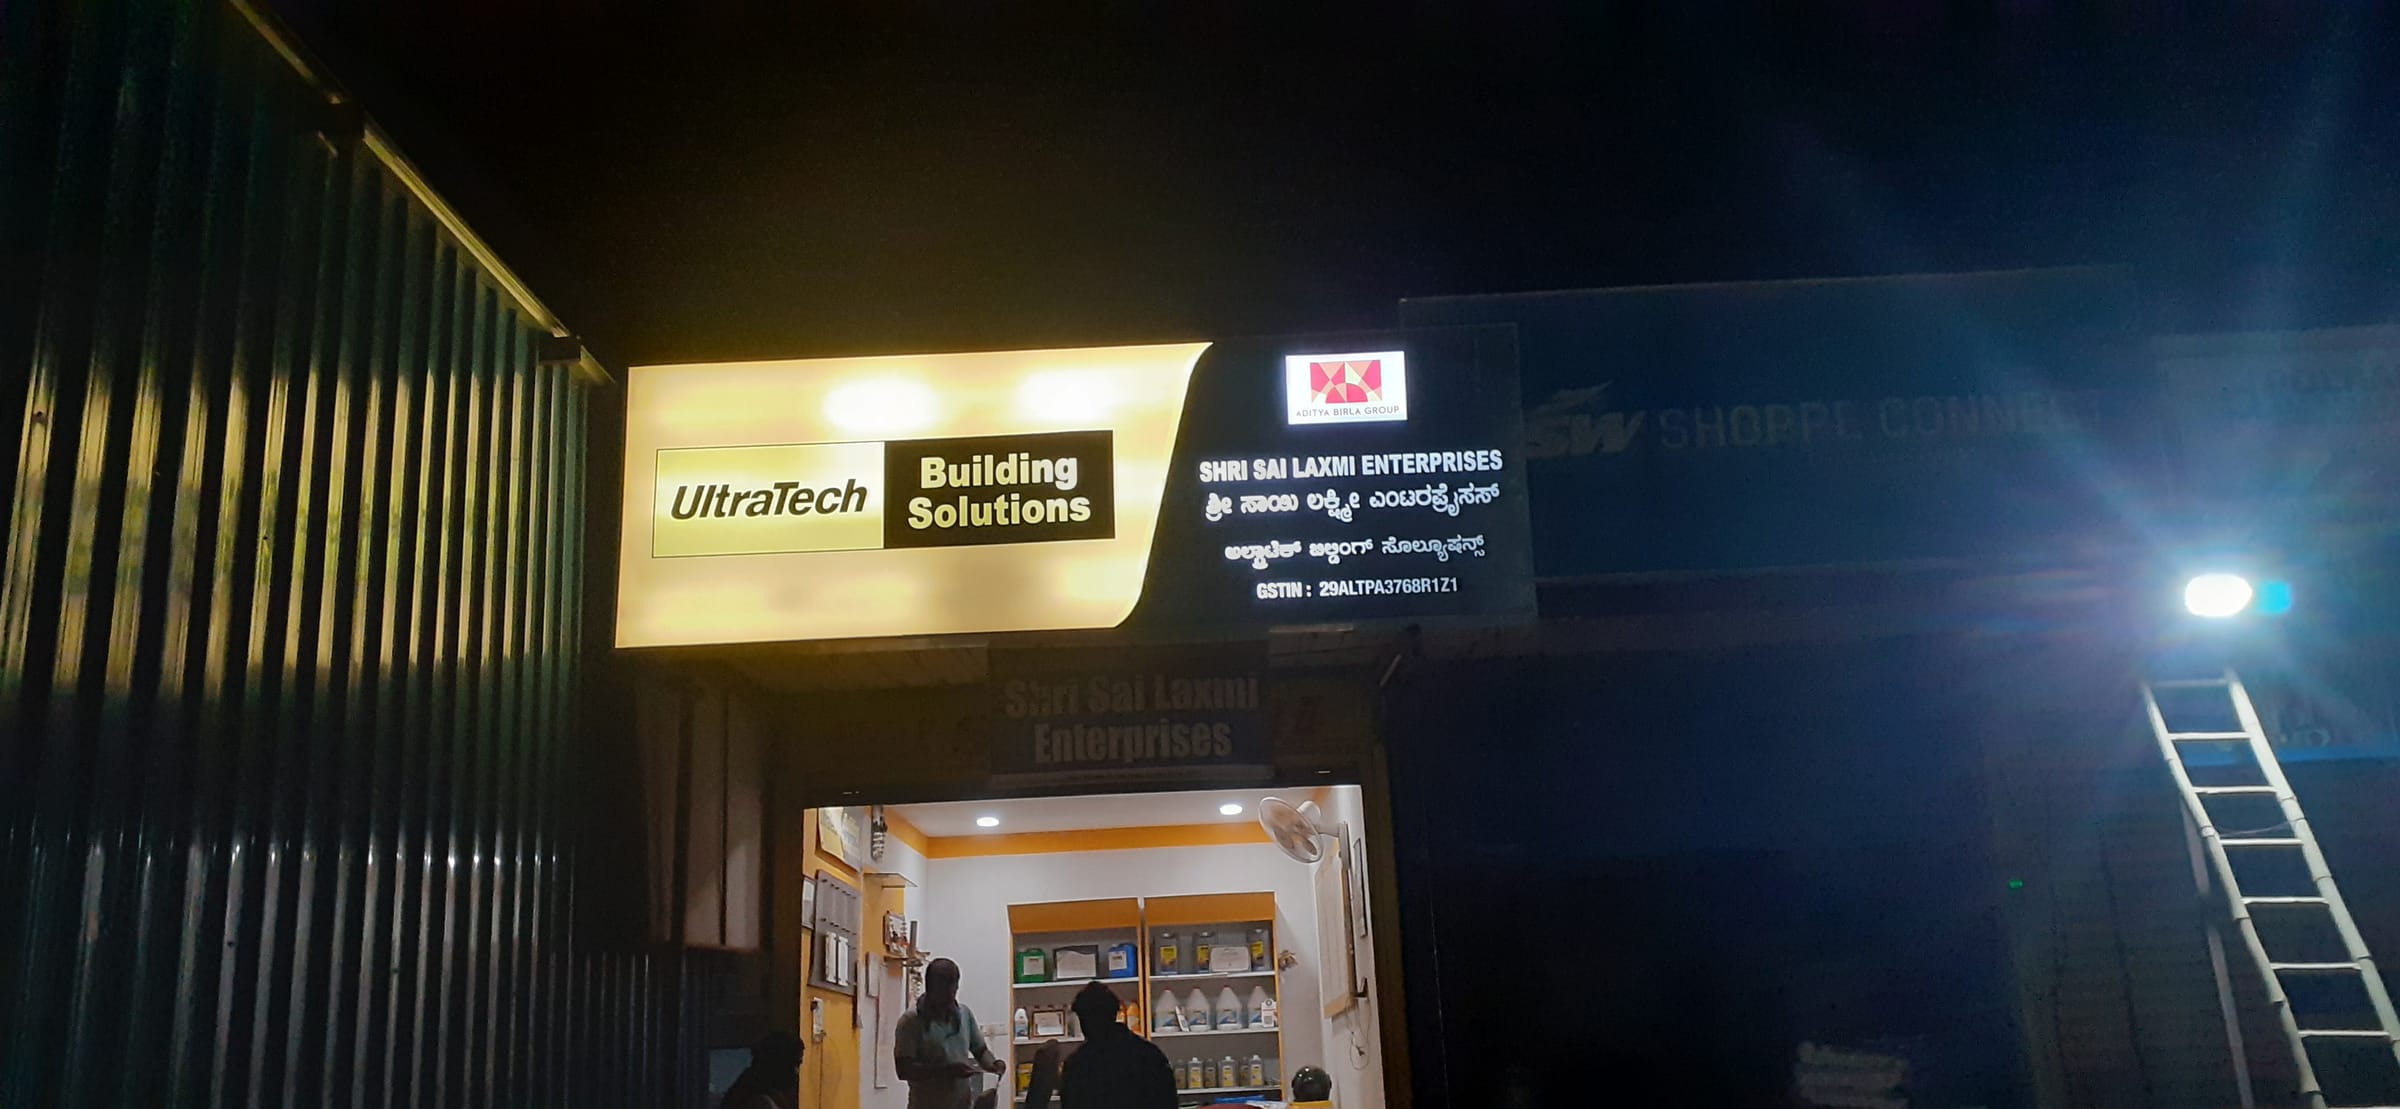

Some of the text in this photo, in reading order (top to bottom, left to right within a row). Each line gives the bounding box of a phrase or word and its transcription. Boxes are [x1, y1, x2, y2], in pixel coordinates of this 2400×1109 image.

[1296, 405, 1400, 417] ADITYA BIRLA GROUP
[920, 452, 1078, 490] Building
[1199, 449, 1503, 483] SHRI SAI LAXMI ENTERPRISES
[671, 478, 867, 520] UltraTech
[907, 492, 1091, 530] Solutions
[1205, 492, 1232, 521] ಶ್ರೀ
[1240, 494, 1299, 514] ಸಾಯಿ
[1256, 582, 1303, 599] GSTIN
[1319, 577, 1458, 597] 29ALTPA3768R1Z1
[1004, 671, 1260, 718] Shri Sai Laxmi
[1034, 718, 1232, 764] Enterprises
